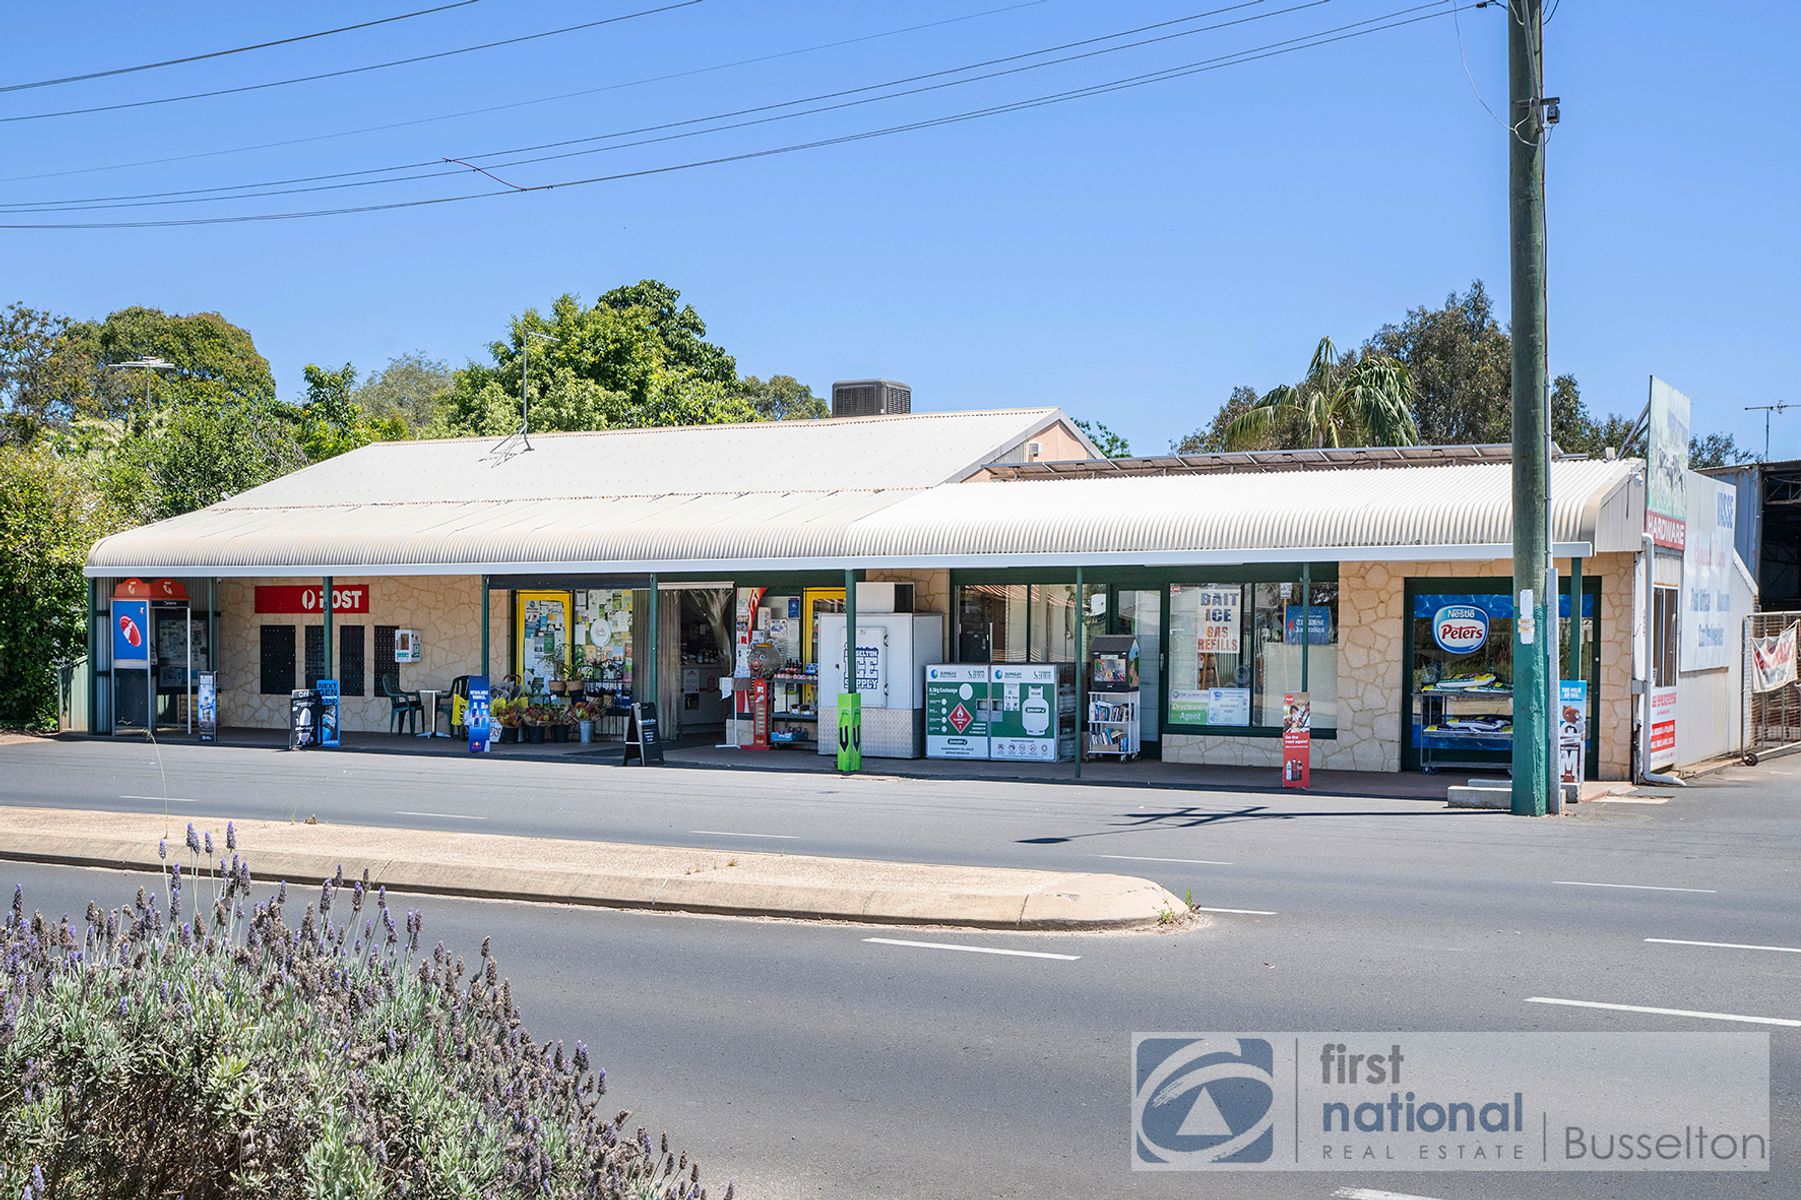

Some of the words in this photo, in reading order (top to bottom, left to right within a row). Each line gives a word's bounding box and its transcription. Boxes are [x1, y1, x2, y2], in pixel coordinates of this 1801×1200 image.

[1647, 513, 1685, 545] HARDWARE
[1201, 593, 1239, 606] BAIT
[1206, 609, 1231, 622] ICE
[1206, 626, 1228, 638] GAS
[1440, 624, 1483, 639] Peters
[1197, 639, 1238, 651] REFILLS
[844, 679, 878, 689] SPPLY
[1180, 712, 1200, 721] Agent
